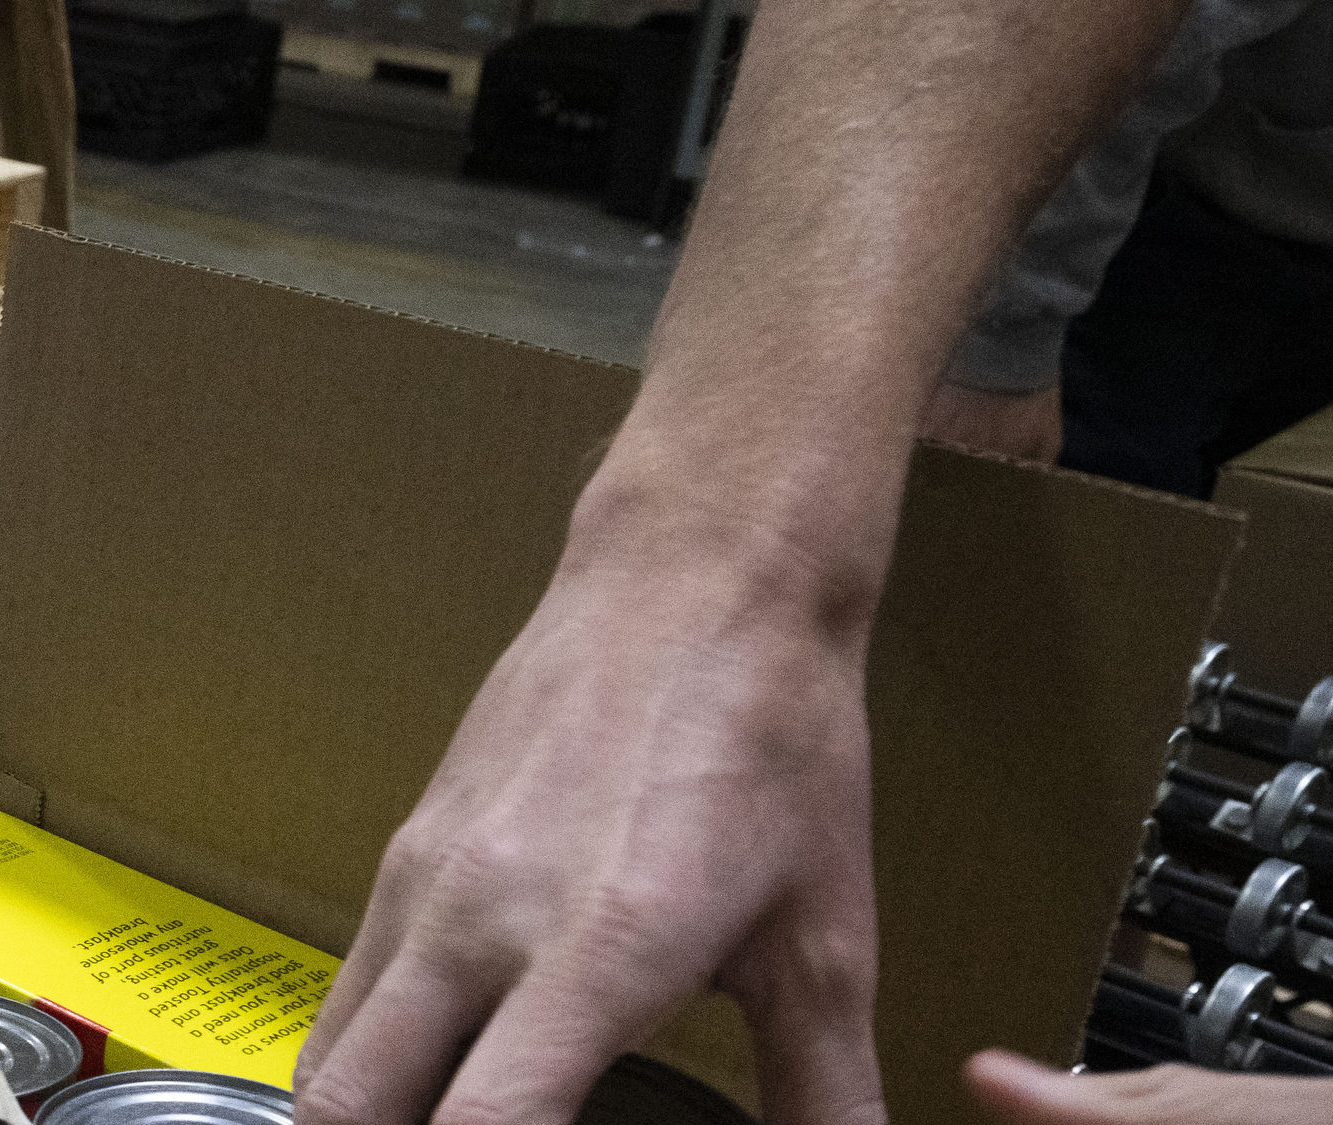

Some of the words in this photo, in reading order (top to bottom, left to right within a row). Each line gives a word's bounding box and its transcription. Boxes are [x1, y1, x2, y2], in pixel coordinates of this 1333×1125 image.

[71, 917, 149, 951] breakfast.
[157, 919, 183, 935] any
[80, 928, 156, 969] wholesome
[147, 926, 213, 958] nutritious
[182, 939, 219, 959] great
[113, 953, 144, 974] part
[222, 945, 254, 962] Oats
[91, 971, 110, 985] of
[120, 957, 182, 985] tasting,
[190, 957, 220, 978] will
[206, 952, 286, 988] Hospitality
[269, 959, 304, 980] good
[304, 970, 329, 984] off
[154, 973, 190, 995] make
[203, 974, 268, 1013] breakfast
[265, 978, 308, 999] right,
[137, 992, 150, 1001] a
[148, 985, 211, 1018] Toasted
[240, 995, 268, 1013] you
[281, 996, 312, 1017] your
[171, 1008, 201, 1028] and
[203, 1009, 238, 1033] need
[189, 1028, 203, 1039] a
[215, 1013, 278, 1046] morning
[261, 1019, 310, 1046] knows
[241, 1044, 261, 1056] to
